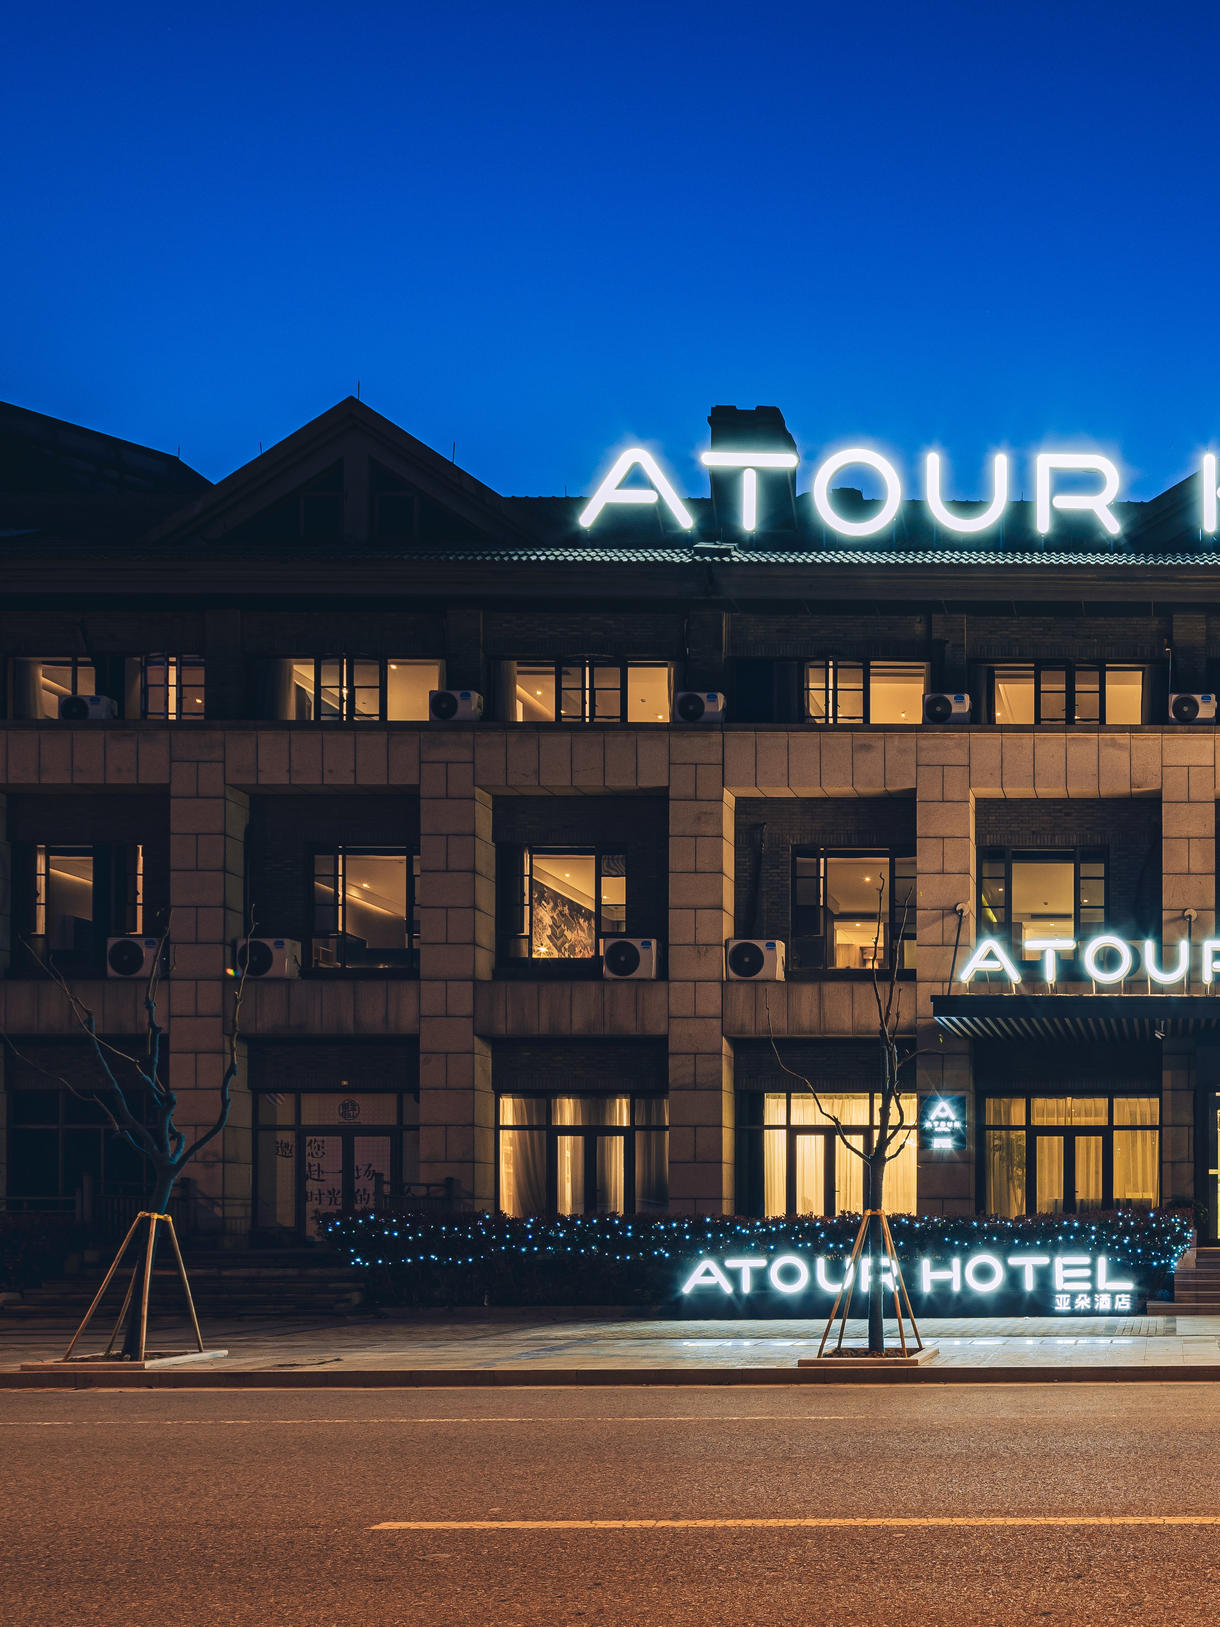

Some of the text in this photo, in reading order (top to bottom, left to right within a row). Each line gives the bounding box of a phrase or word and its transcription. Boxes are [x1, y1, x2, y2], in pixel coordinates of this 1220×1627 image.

[577, 447, 1121, 536] ATOUR
[681, 1254, 1134, 1294] ATOUR HOTEL
[1055, 1293, 1131, 1310] 亚朵酒店
